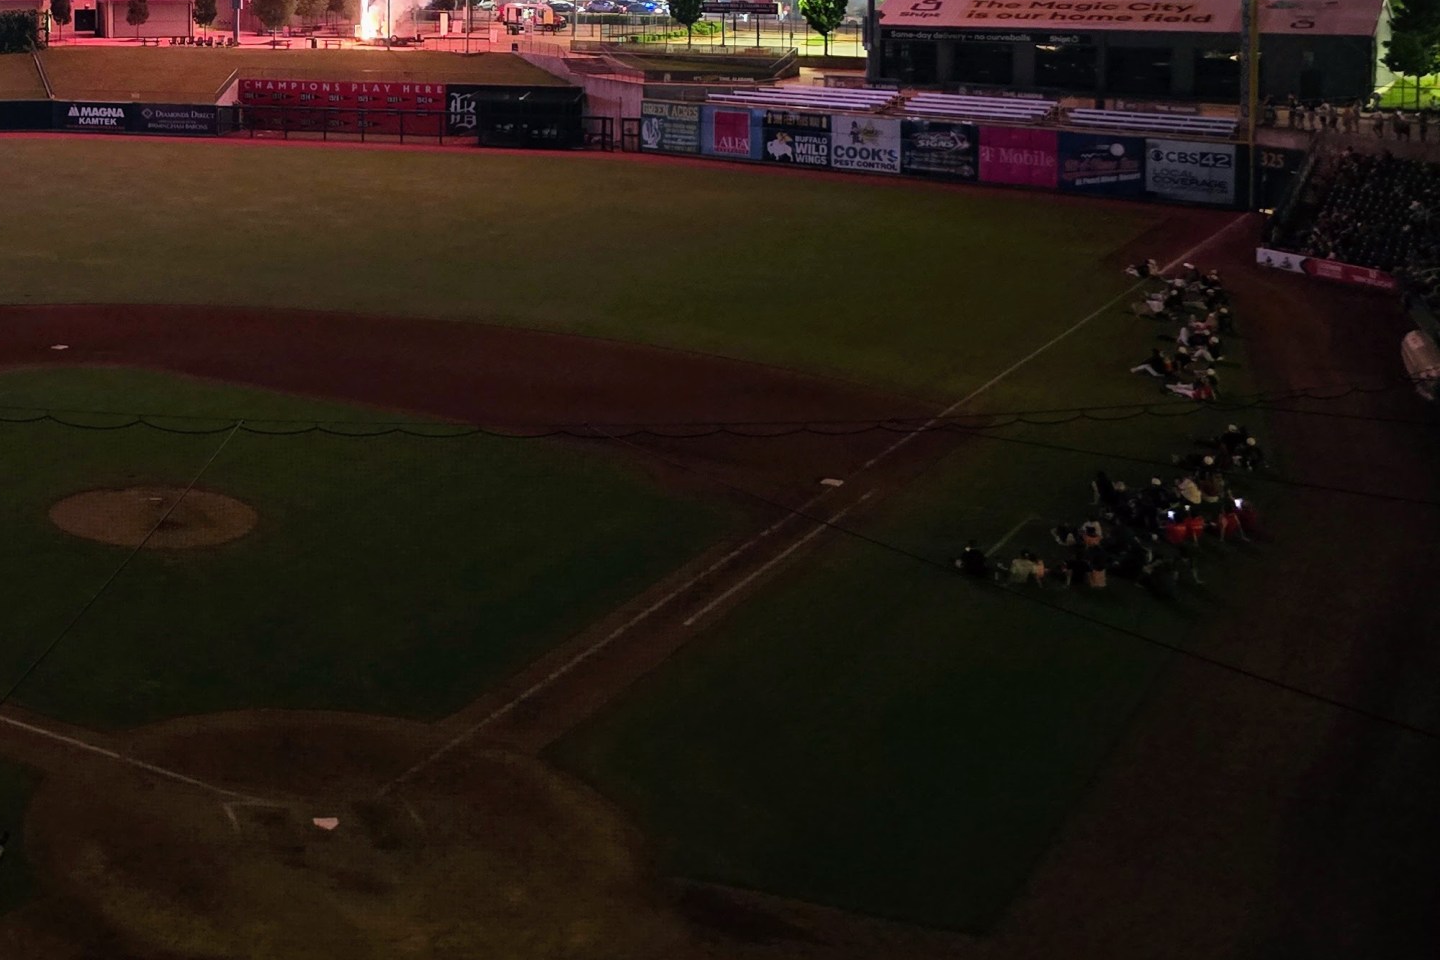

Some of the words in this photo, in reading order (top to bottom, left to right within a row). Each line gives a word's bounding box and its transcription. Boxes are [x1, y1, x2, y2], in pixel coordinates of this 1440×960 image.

[971, 0, 1020, 9] The
[1029, 1, 1117, 11] Magic
[1128, 2, 1193, 12] City
[966, 10, 986, 19] is
[996, 12, 1043, 20] our
[1049, 11, 1132, 22] home
[1143, 12, 1212, 23] field
[244, 81, 340, 92] CHAMPIONS
[351, 83, 391, 93] PLAY
[402, 85, 443, 94] HERE
[80, 107, 125, 118] MAGNA
[671, 105, 698, 117] ACRES
[79, 117, 117, 125] KAMTEK
[720, 136, 749, 150] ALFA
[795, 135, 827, 145] BUFFALO
[795, 143, 827, 155] WILD
[834, 145, 898, 162] COOK'S
[795, 154, 827, 165] WINGS
[999, 148, 1055, 167] Mobile
[1166, 151, 1198, 164] CBS
[1200, 152, 1231, 168] 42
[1260, 152, 1284, 168] 325
[834, 159, 854, 167] PEST
[856, 160, 897, 171] CONTROL
[1153, 168, 1193, 177] LOCAL
[1152, 176, 1227, 188] COVERAGE
